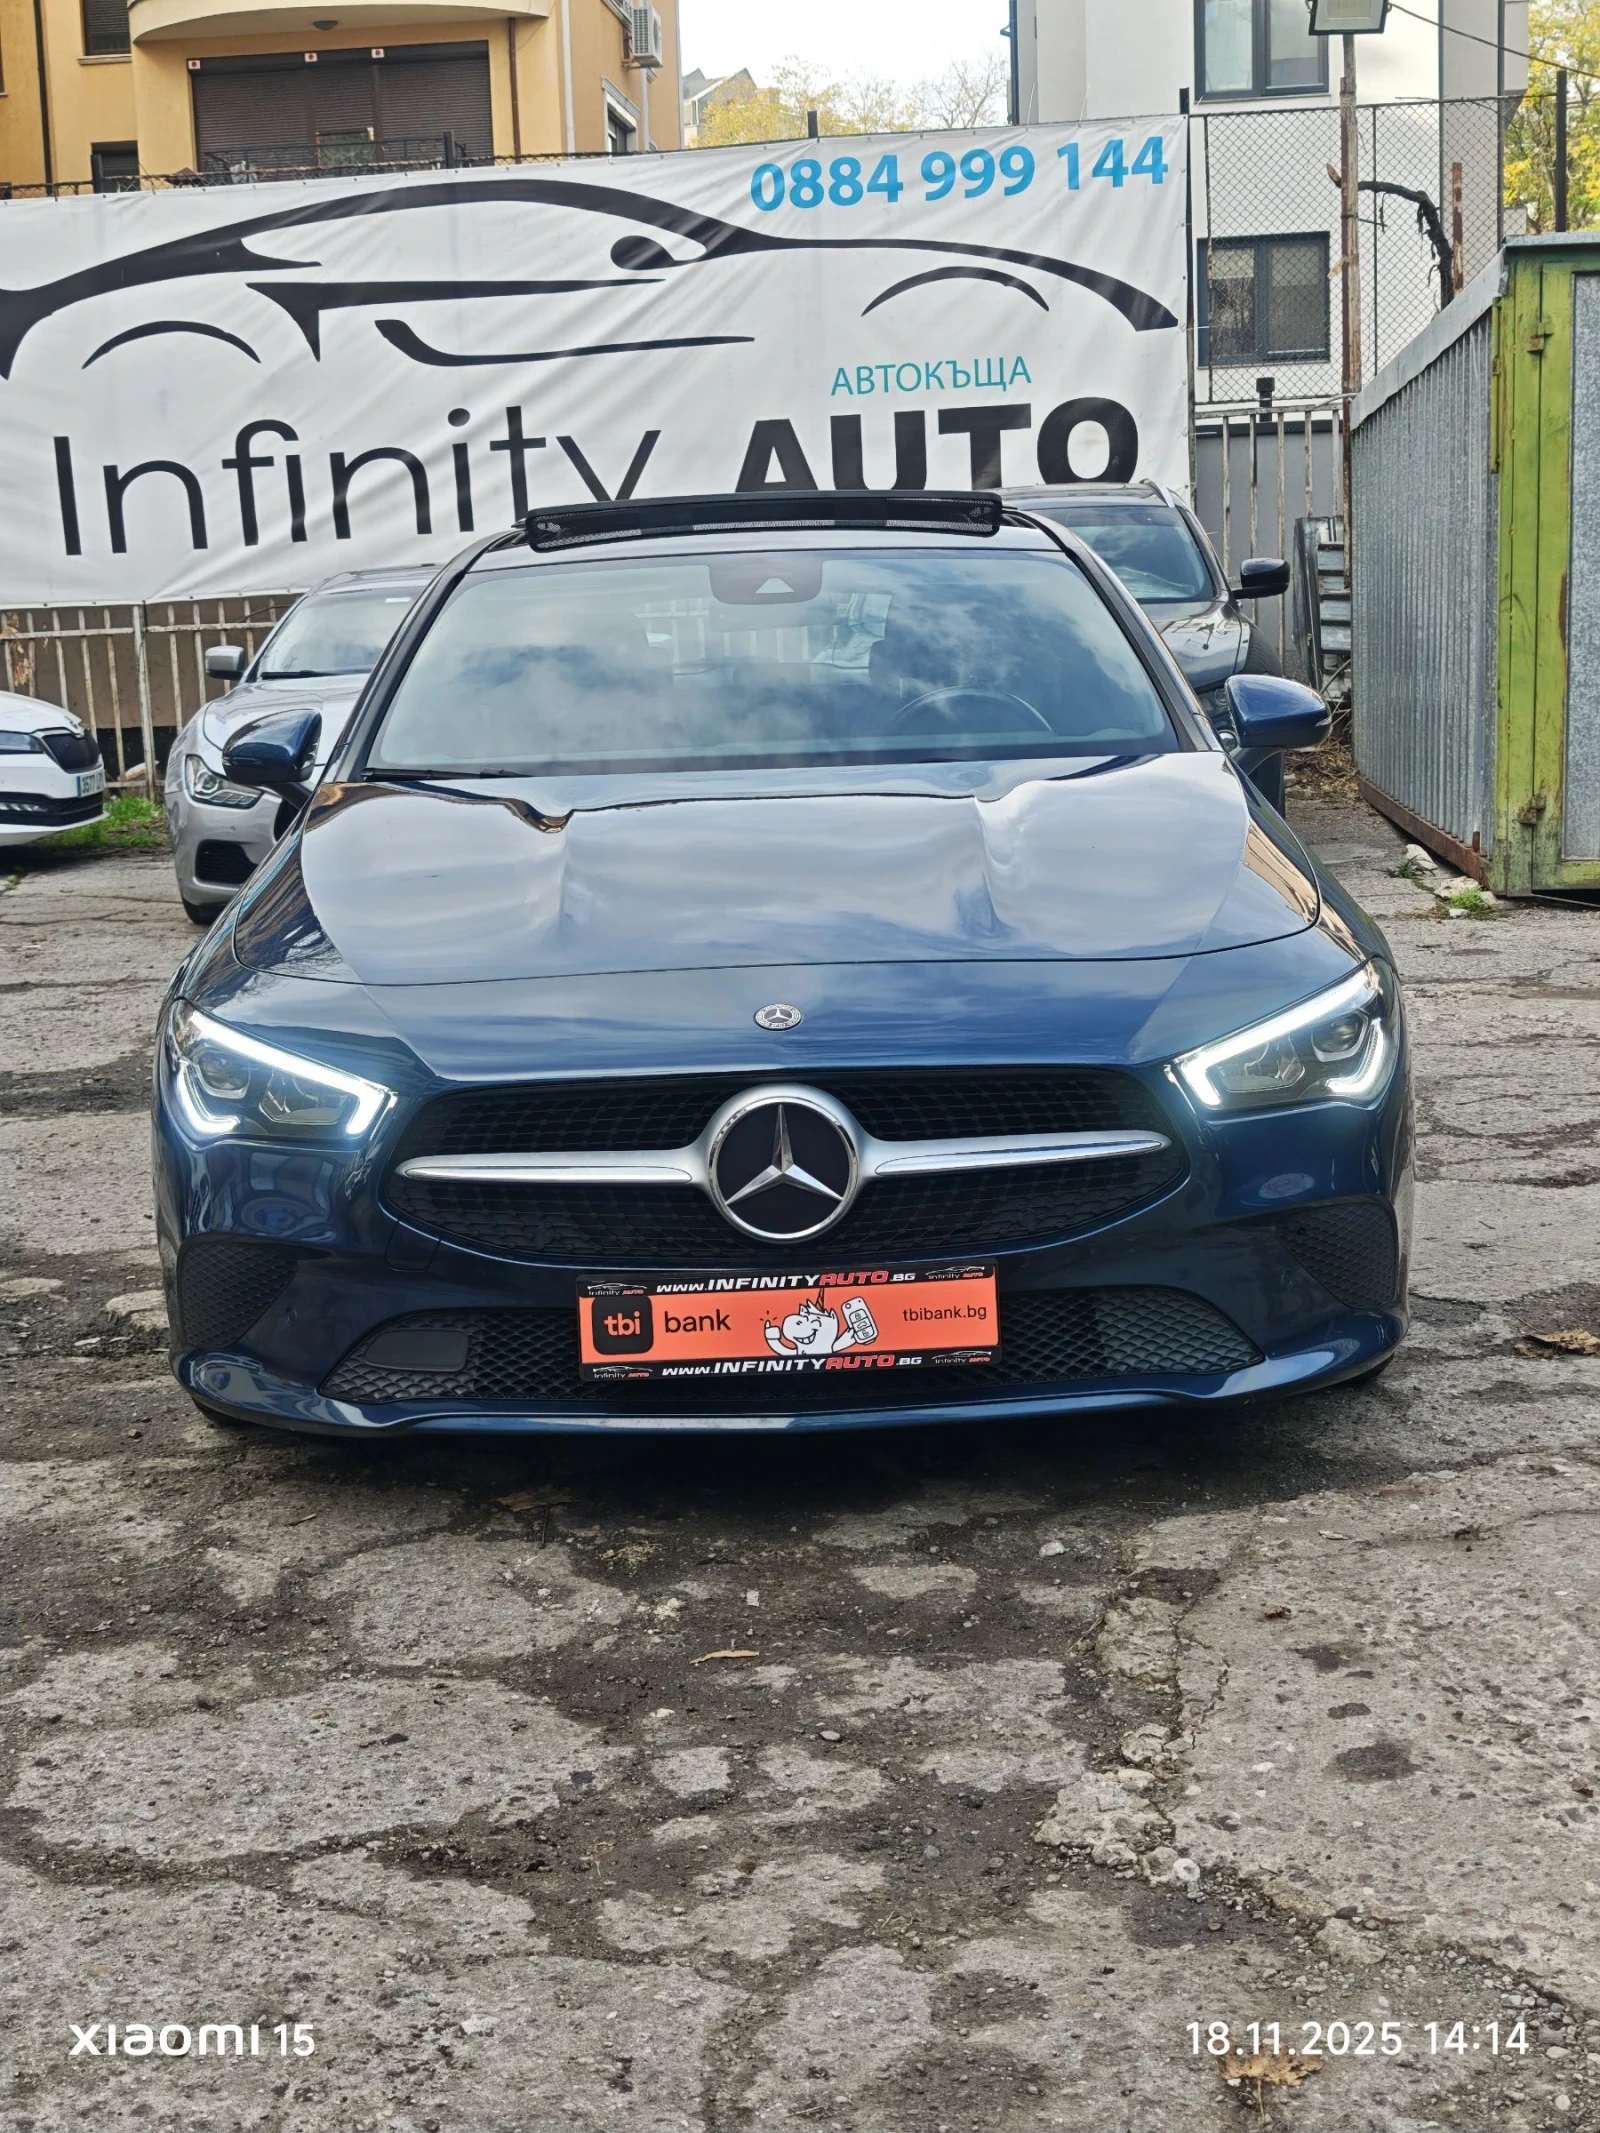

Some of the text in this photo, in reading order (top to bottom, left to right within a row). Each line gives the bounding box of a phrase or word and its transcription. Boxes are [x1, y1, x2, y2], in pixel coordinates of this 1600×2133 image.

[750, 136, 1169, 212] 0884 999 144
[830, 355, 1032, 397] АВТОКЪЩА
[53, 396, 1139, 556] Infinity AUTO
[603, 1310, 641, 1336] tbi
[663, 1308, 731, 1333] bank
[902, 1304, 987, 1322] tbibank.bg
